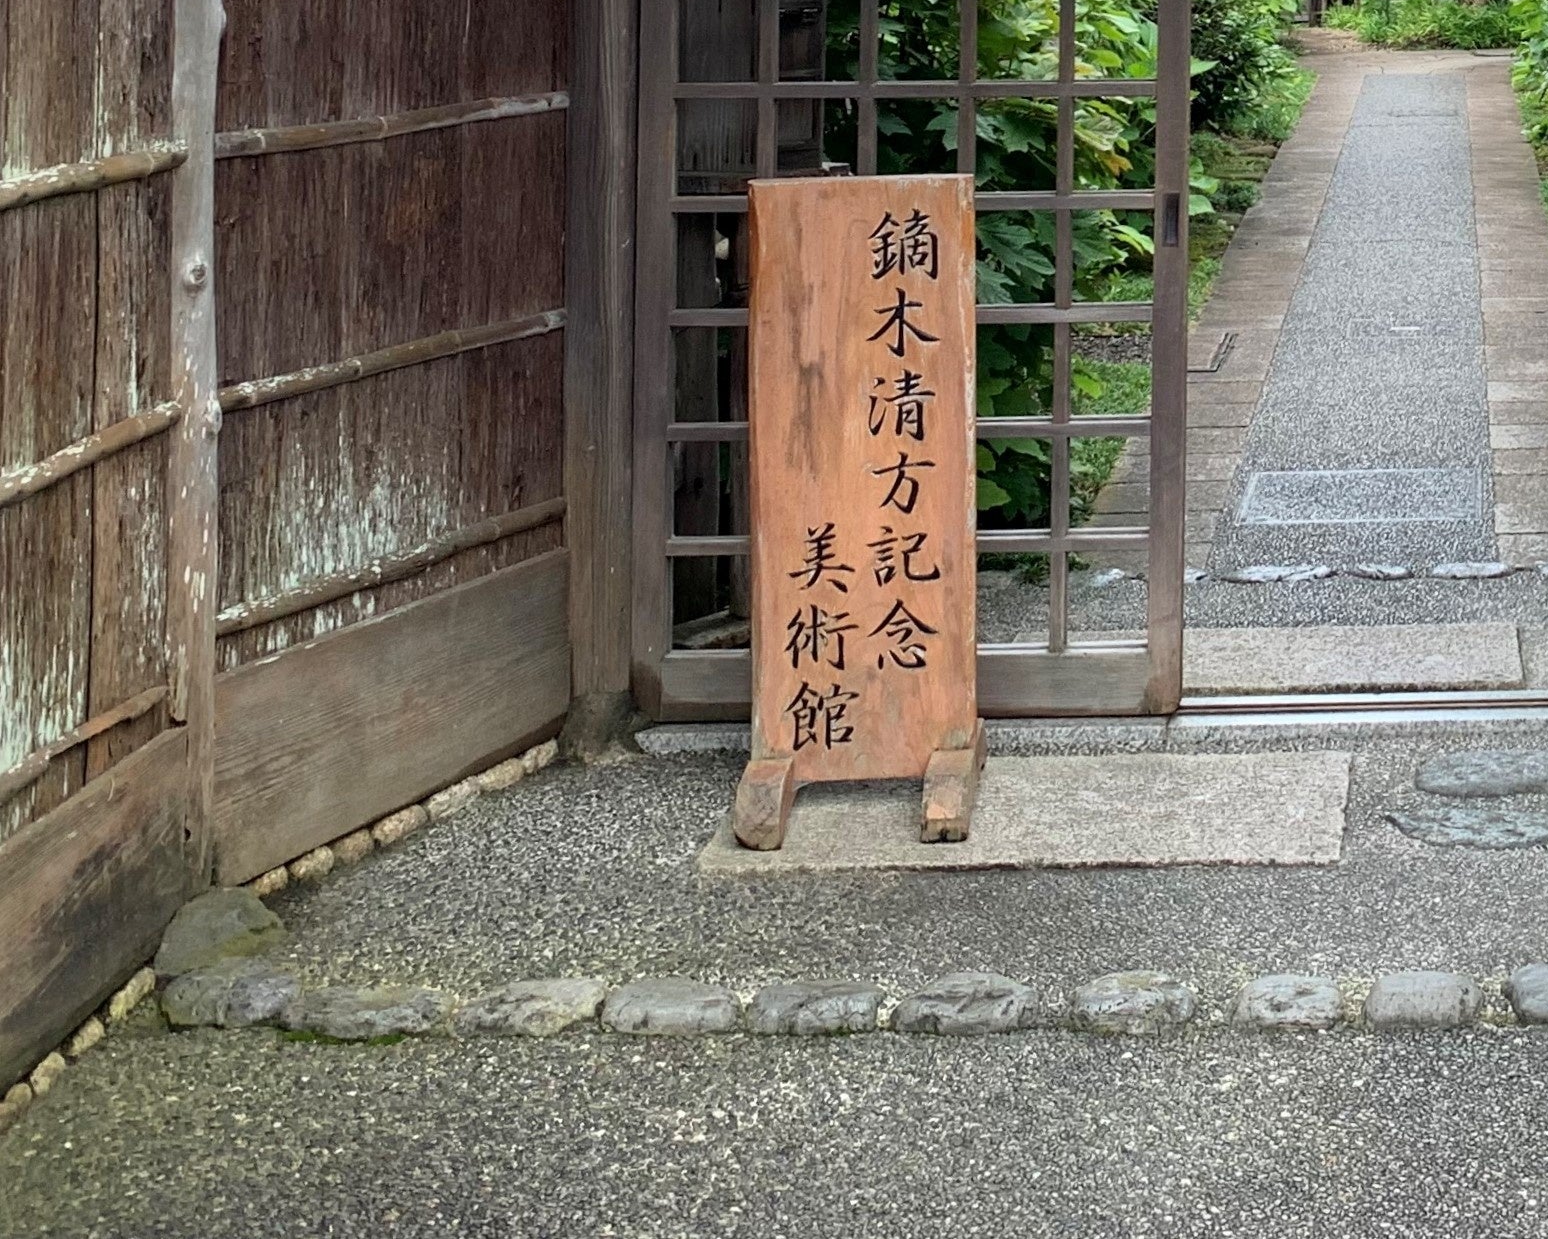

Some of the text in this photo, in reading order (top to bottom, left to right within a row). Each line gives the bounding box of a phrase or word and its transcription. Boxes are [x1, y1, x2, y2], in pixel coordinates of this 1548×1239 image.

[866, 208, 941, 671] 鏑木清方記念
[784, 521, 859, 753] 美術館
